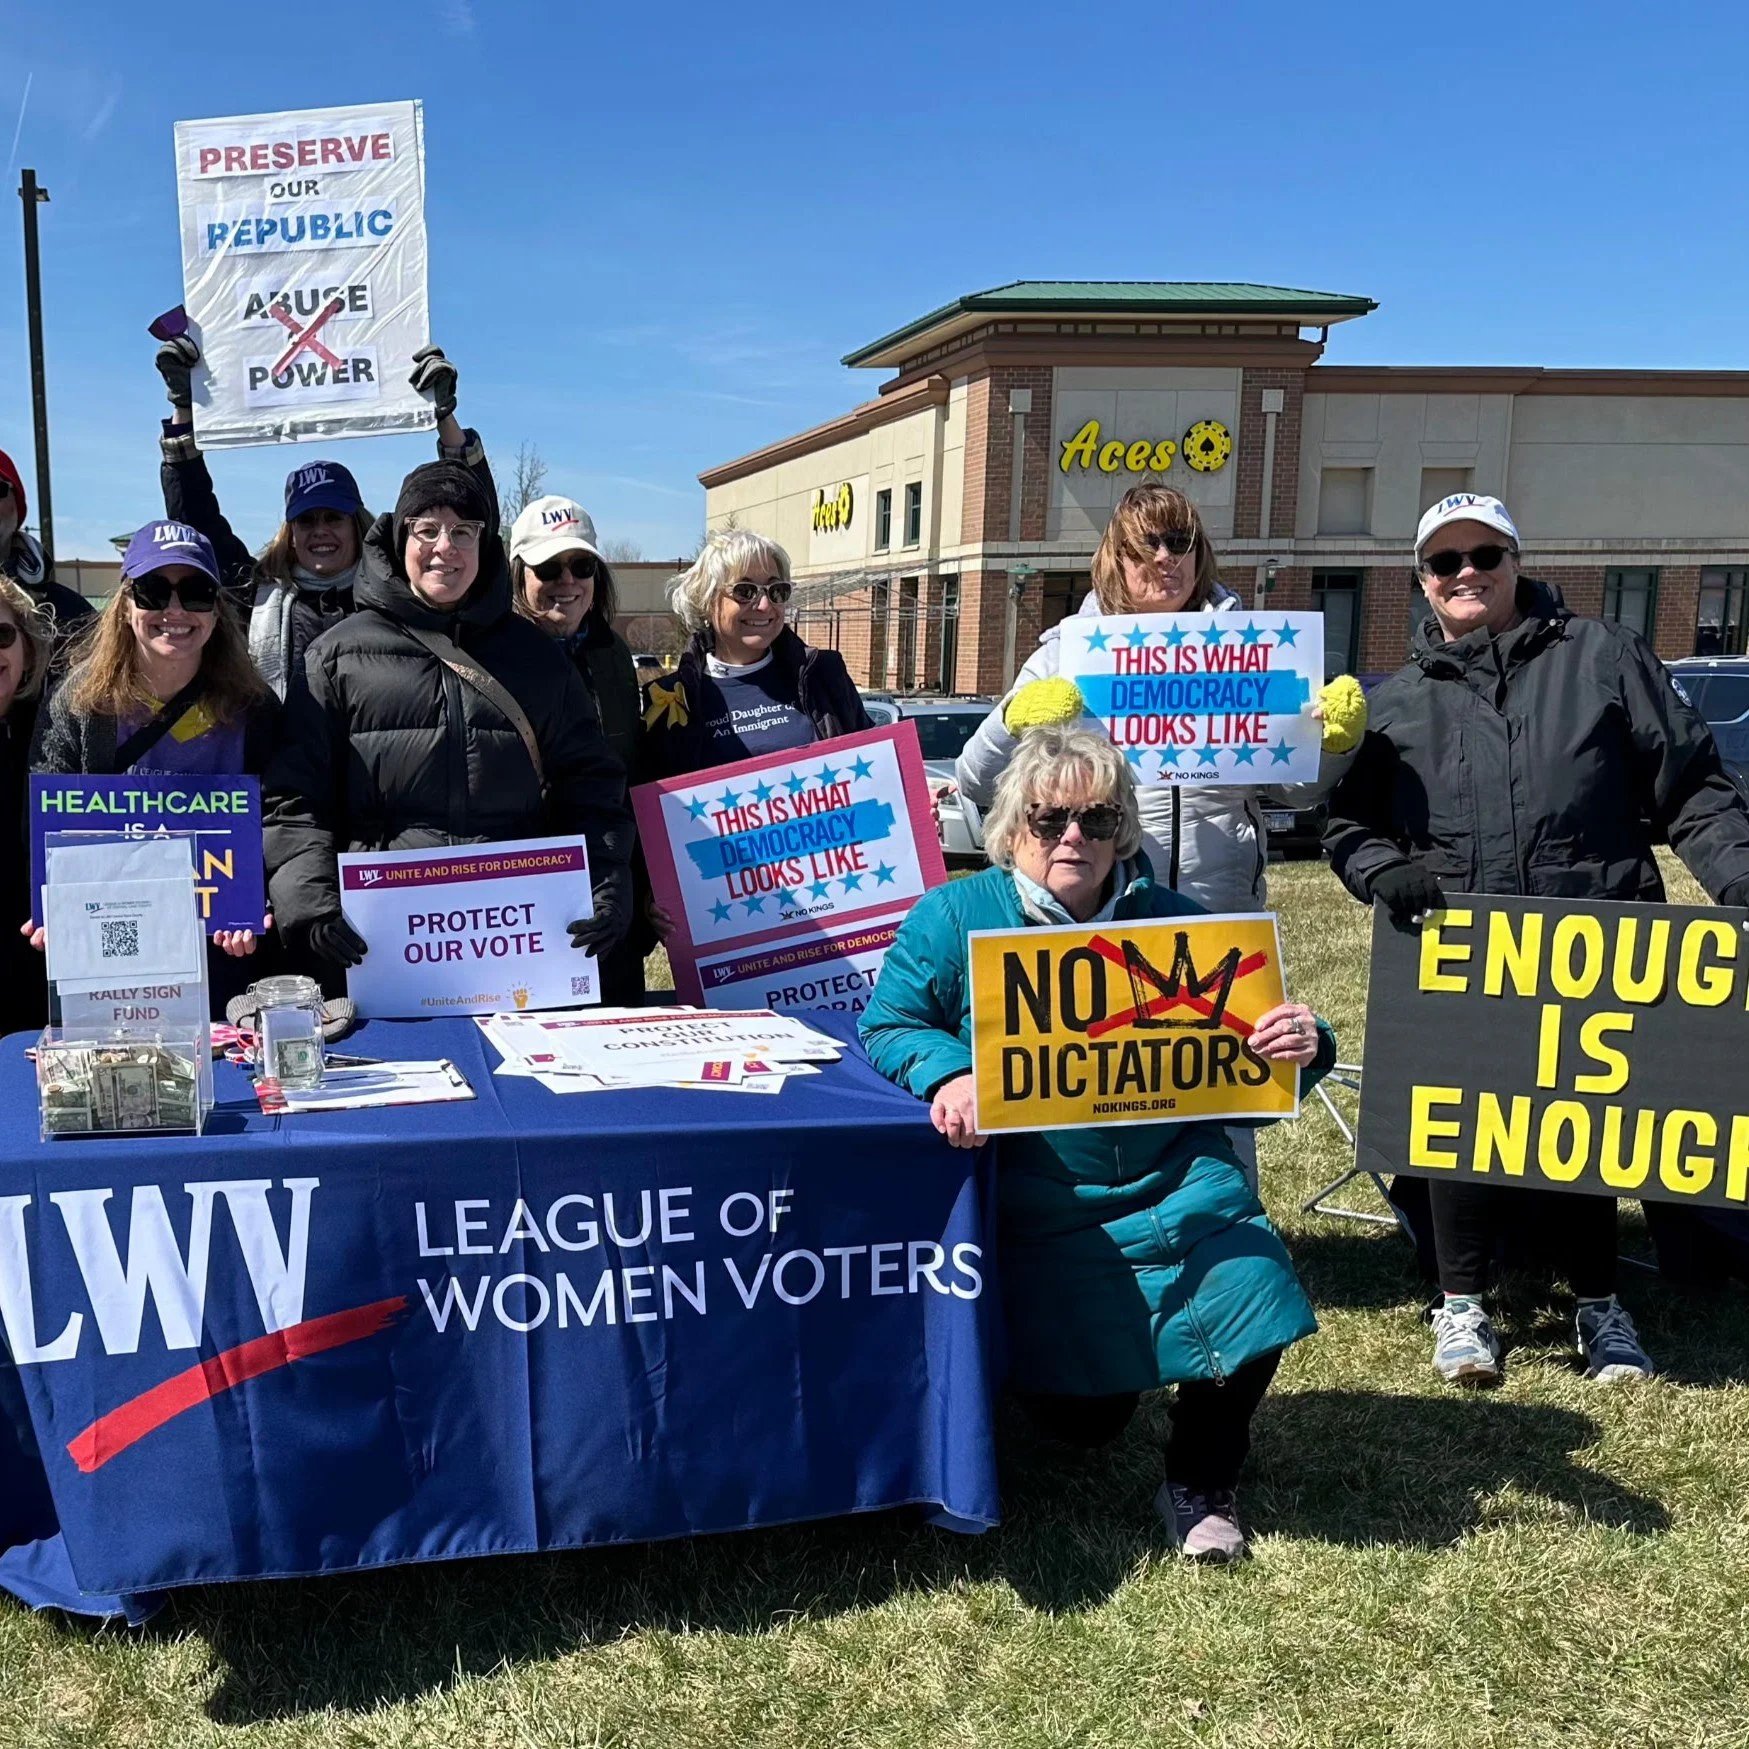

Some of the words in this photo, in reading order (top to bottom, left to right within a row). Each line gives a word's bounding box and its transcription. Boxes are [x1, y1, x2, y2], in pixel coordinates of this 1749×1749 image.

[200, 133, 392, 174] PRESERVE
[270, 179, 320, 199] OUR
[207, 209, 393, 250] REPUBLIC
[243, 285, 368, 320] ABUSE
[248, 358, 375, 391] POWER
[1059, 419, 1176, 472] Aces
[299, 467, 328, 488] LWV
[541, 508, 571, 525] LWV
[812, 488, 840, 533] Aces
[153, 525, 195, 542] LWV
[1112, 645, 1167, 676] THIS
[1174, 645, 1197, 675] IS
[1202, 644, 1273, 674] WHAT
[1111, 677, 1271, 711] DEMOCRACY
[713, 728, 730, 738] An
[732, 715, 789, 733] Immigrant
[731, 704, 782, 721] Daughter
[1109, 713, 1196, 746] LOOKS
[1206, 712, 1270, 744] LIKE
[1175, 771, 1189, 780] NO
[1190, 771, 1220, 780] KINGS
[41, 790, 249, 814] HEALTHCARE
[711, 802, 763, 838] THIS
[766, 796, 789, 826] IS
[789, 780, 852, 818] WHAT
[124, 822, 145, 840] IS
[153, 823, 171, 840] A
[719, 811, 857, 868] DEMOCRACY
[359, 869, 380, 881] LWV
[385, 868, 422, 881] UNITE
[424, 866, 449, 878] AND
[451, 863, 477, 875] RISE
[479, 860, 501, 872] FOR
[503, 854, 573, 870] DEMOCRACY
[725, 856, 804, 900] LOOKS
[809, 841, 868, 880] LIKE
[408, 903, 535, 935] PROTECT
[795, 908, 808, 917] NO
[809, 902, 835, 914] KINGS
[404, 940, 463, 964] OUR
[470, 932, 544, 958] VOTE
[713, 966, 732, 979] LWV
[737, 961, 771, 974] UNITE
[772, 953, 795, 966] AND
[797, 947, 823, 960] RISE
[823, 941, 846, 954] FOR
[847, 929, 896, 949] DEMOCR
[1419, 909, 1749, 1010] ENOUG
[89, 986, 139, 1001] RALLY
[143, 985, 181, 999] SIGN
[421, 993, 501, 1007] #UniteAndRise
[766, 968, 877, 1010] PROTECT
[1003, 946, 1107, 1036] NO
[113, 1007, 160, 1021] FUND
[619, 1022, 732, 1034] PROTECT
[603, 1032, 794, 1050] CONSTITUTION
[662, 1030, 716, 1039] OUR
[1536, 1004, 1634, 1094] IS
[1002, 1035, 1271, 1101] DICTATORS
[1093, 1098, 1176, 1114] NOKINGS.ORG
[415, 1187, 695, 1257] LEAGUE
[719, 1189, 794, 1237] OF
[0, 1176, 321, 1365] LWV
[417, 1261, 706, 1334] WOMEN
[723, 1240, 983, 1310] VOTERS
